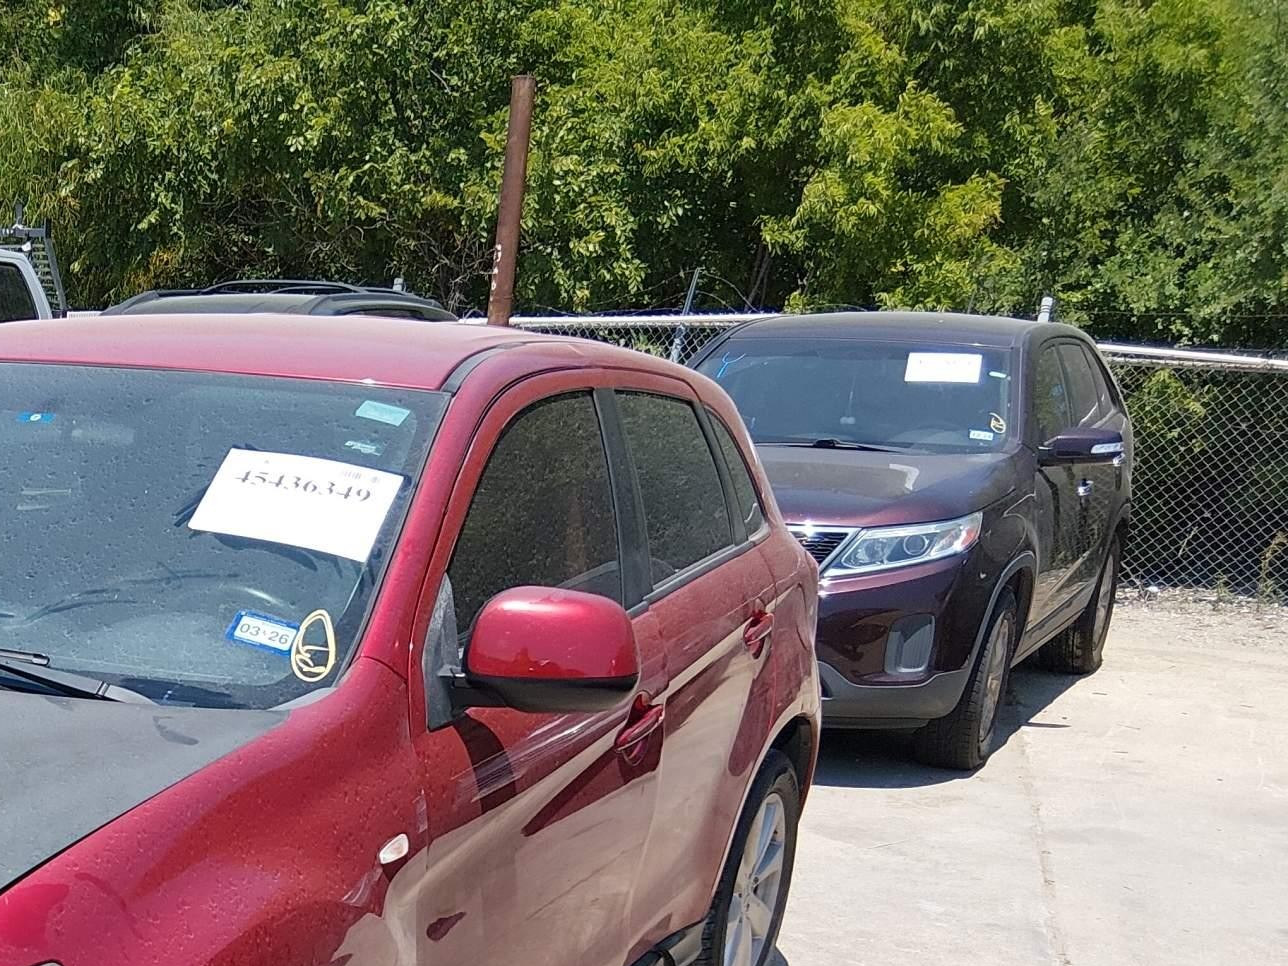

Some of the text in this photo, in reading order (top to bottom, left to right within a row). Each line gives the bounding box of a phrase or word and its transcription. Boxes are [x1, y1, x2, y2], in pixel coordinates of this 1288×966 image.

[235, 469, 372, 502] 45436349
[239, 623, 290, 645] 03 26
